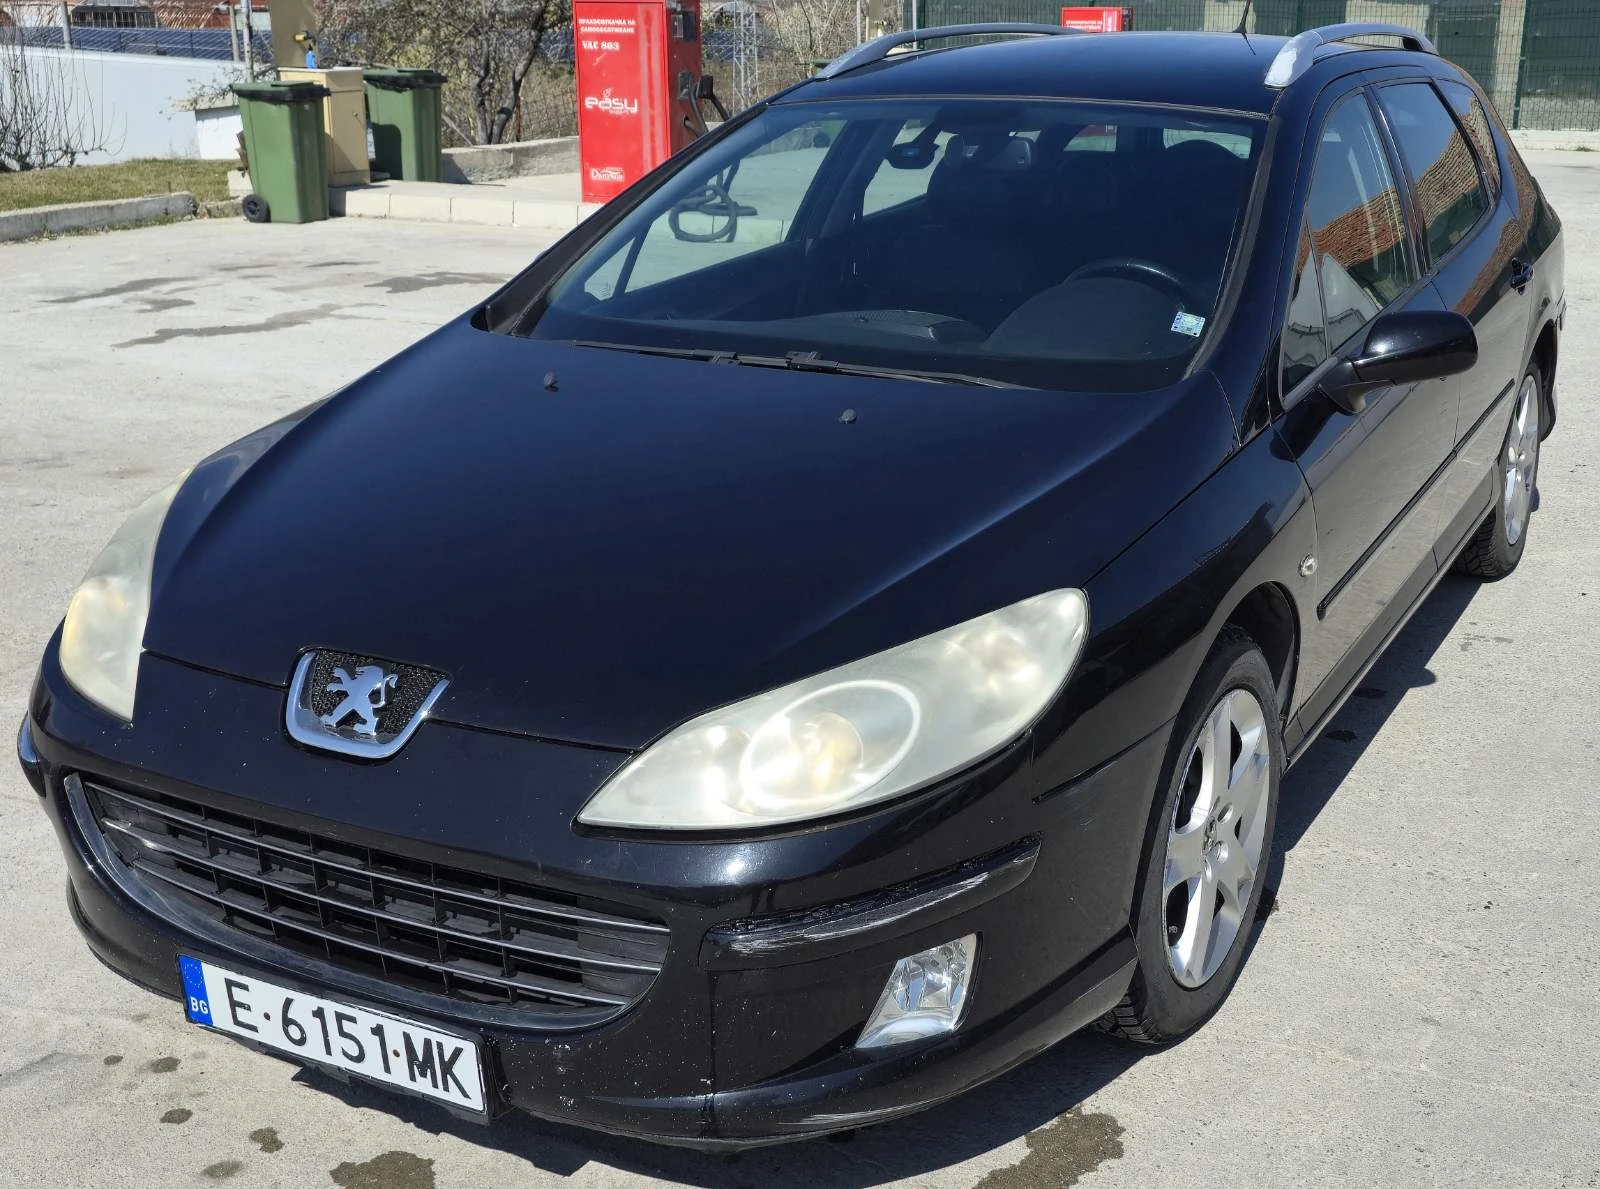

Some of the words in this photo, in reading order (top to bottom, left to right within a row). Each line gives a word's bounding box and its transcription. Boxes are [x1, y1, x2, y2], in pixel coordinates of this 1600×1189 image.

[585, 96, 638, 114] easy
[190, 997, 209, 1015] BG
[225, 978, 259, 1033] E
[282, 997, 391, 1075] 6151
[403, 1031, 472, 1100] MK
